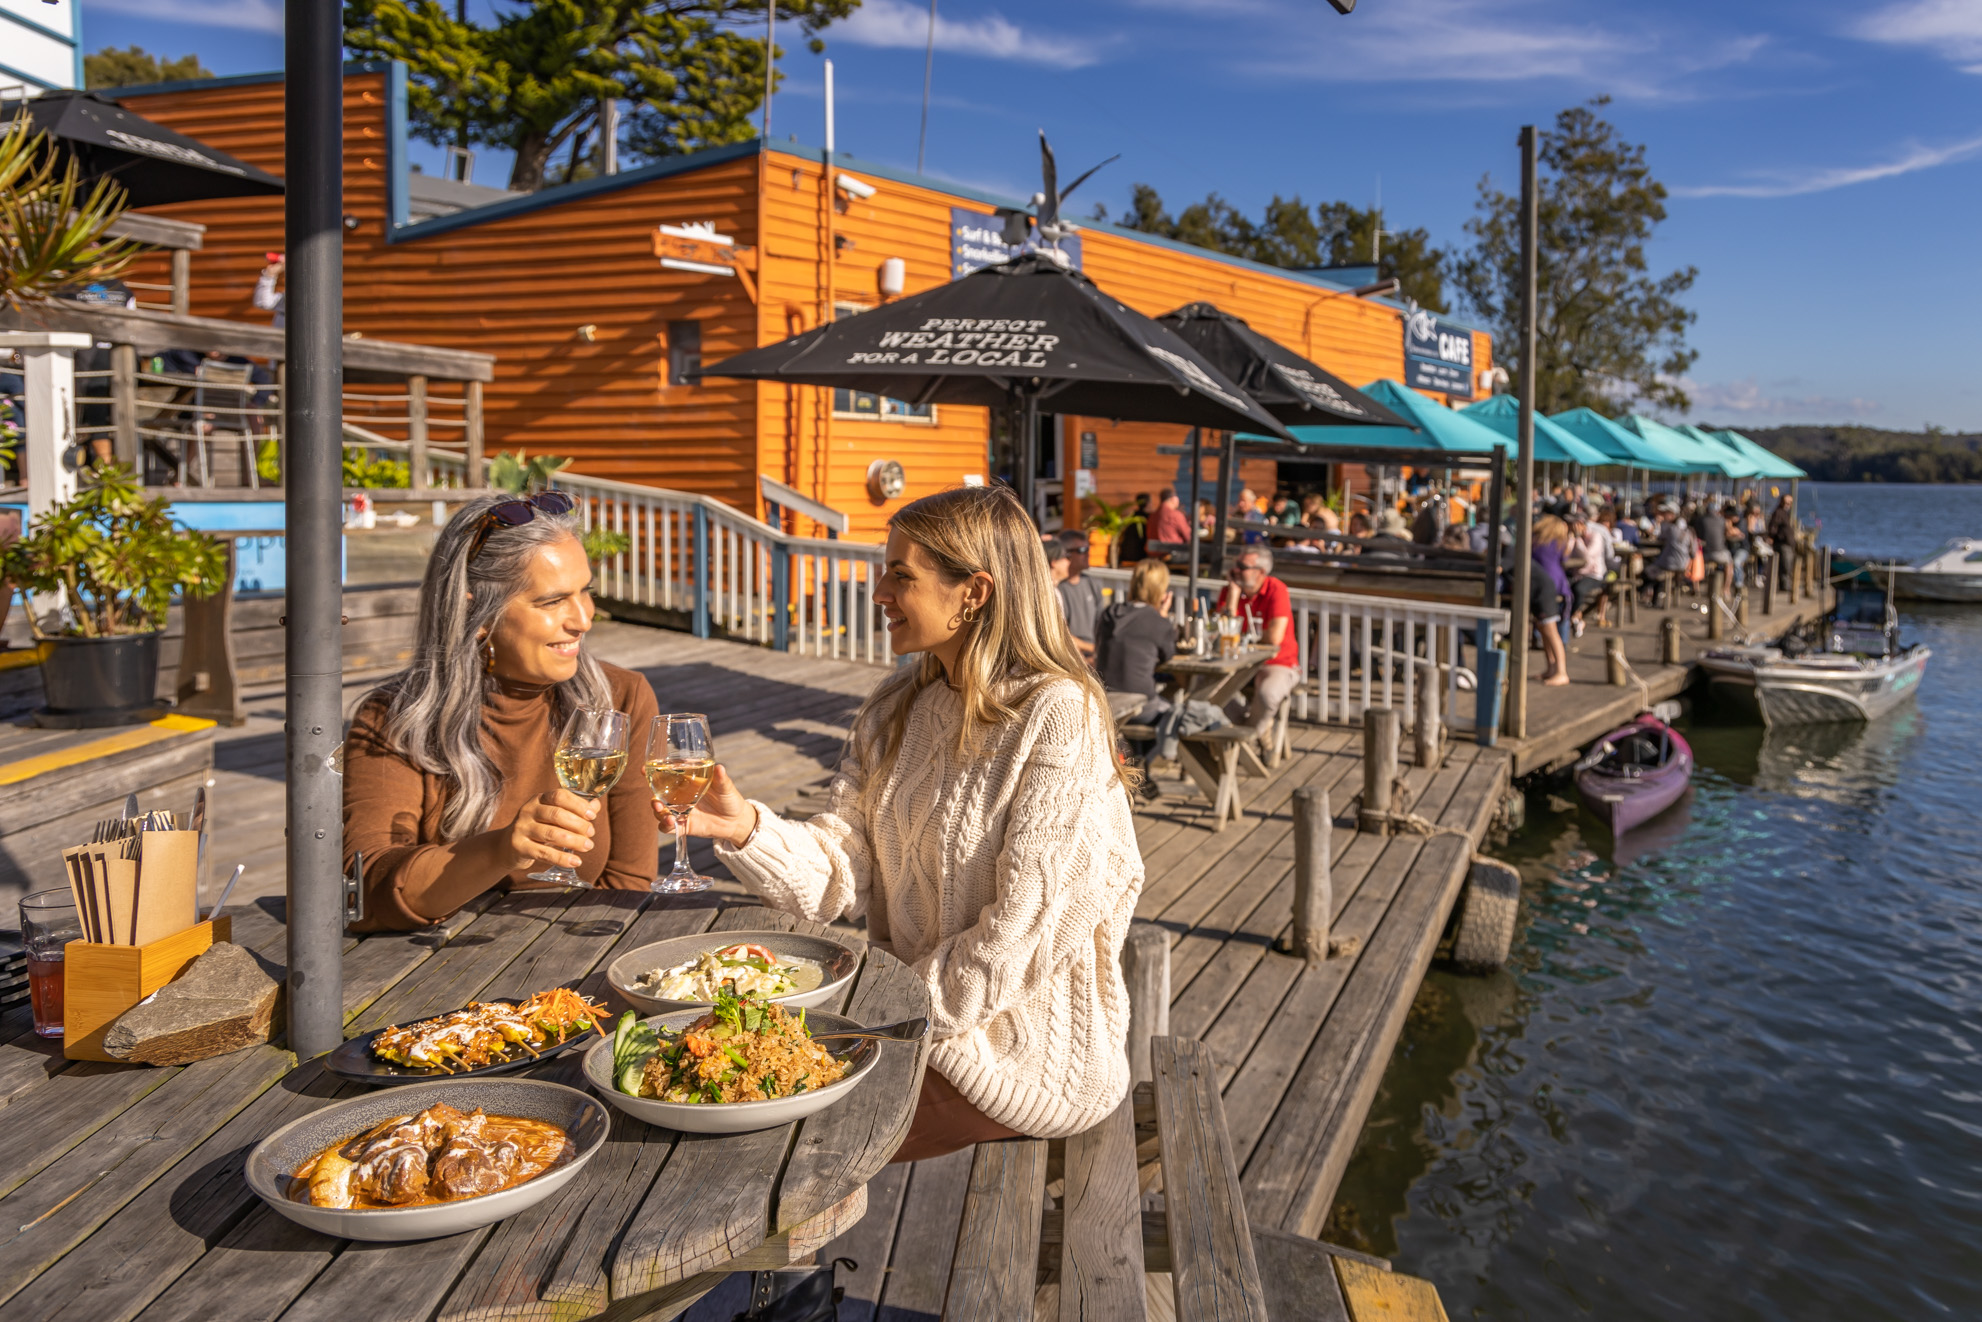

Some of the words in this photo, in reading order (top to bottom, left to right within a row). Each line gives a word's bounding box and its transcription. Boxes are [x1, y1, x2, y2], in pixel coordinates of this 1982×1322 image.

[962, 225, 982, 243] Surf
[920, 318, 1047, 333] PERFECT
[878, 331, 1060, 351] WEATHER
[1438, 332, 1470, 366] CAFE
[846, 352, 900, 364] FOR
[900, 352, 919, 364] A
[924, 349, 1047, 368] LOCAL
